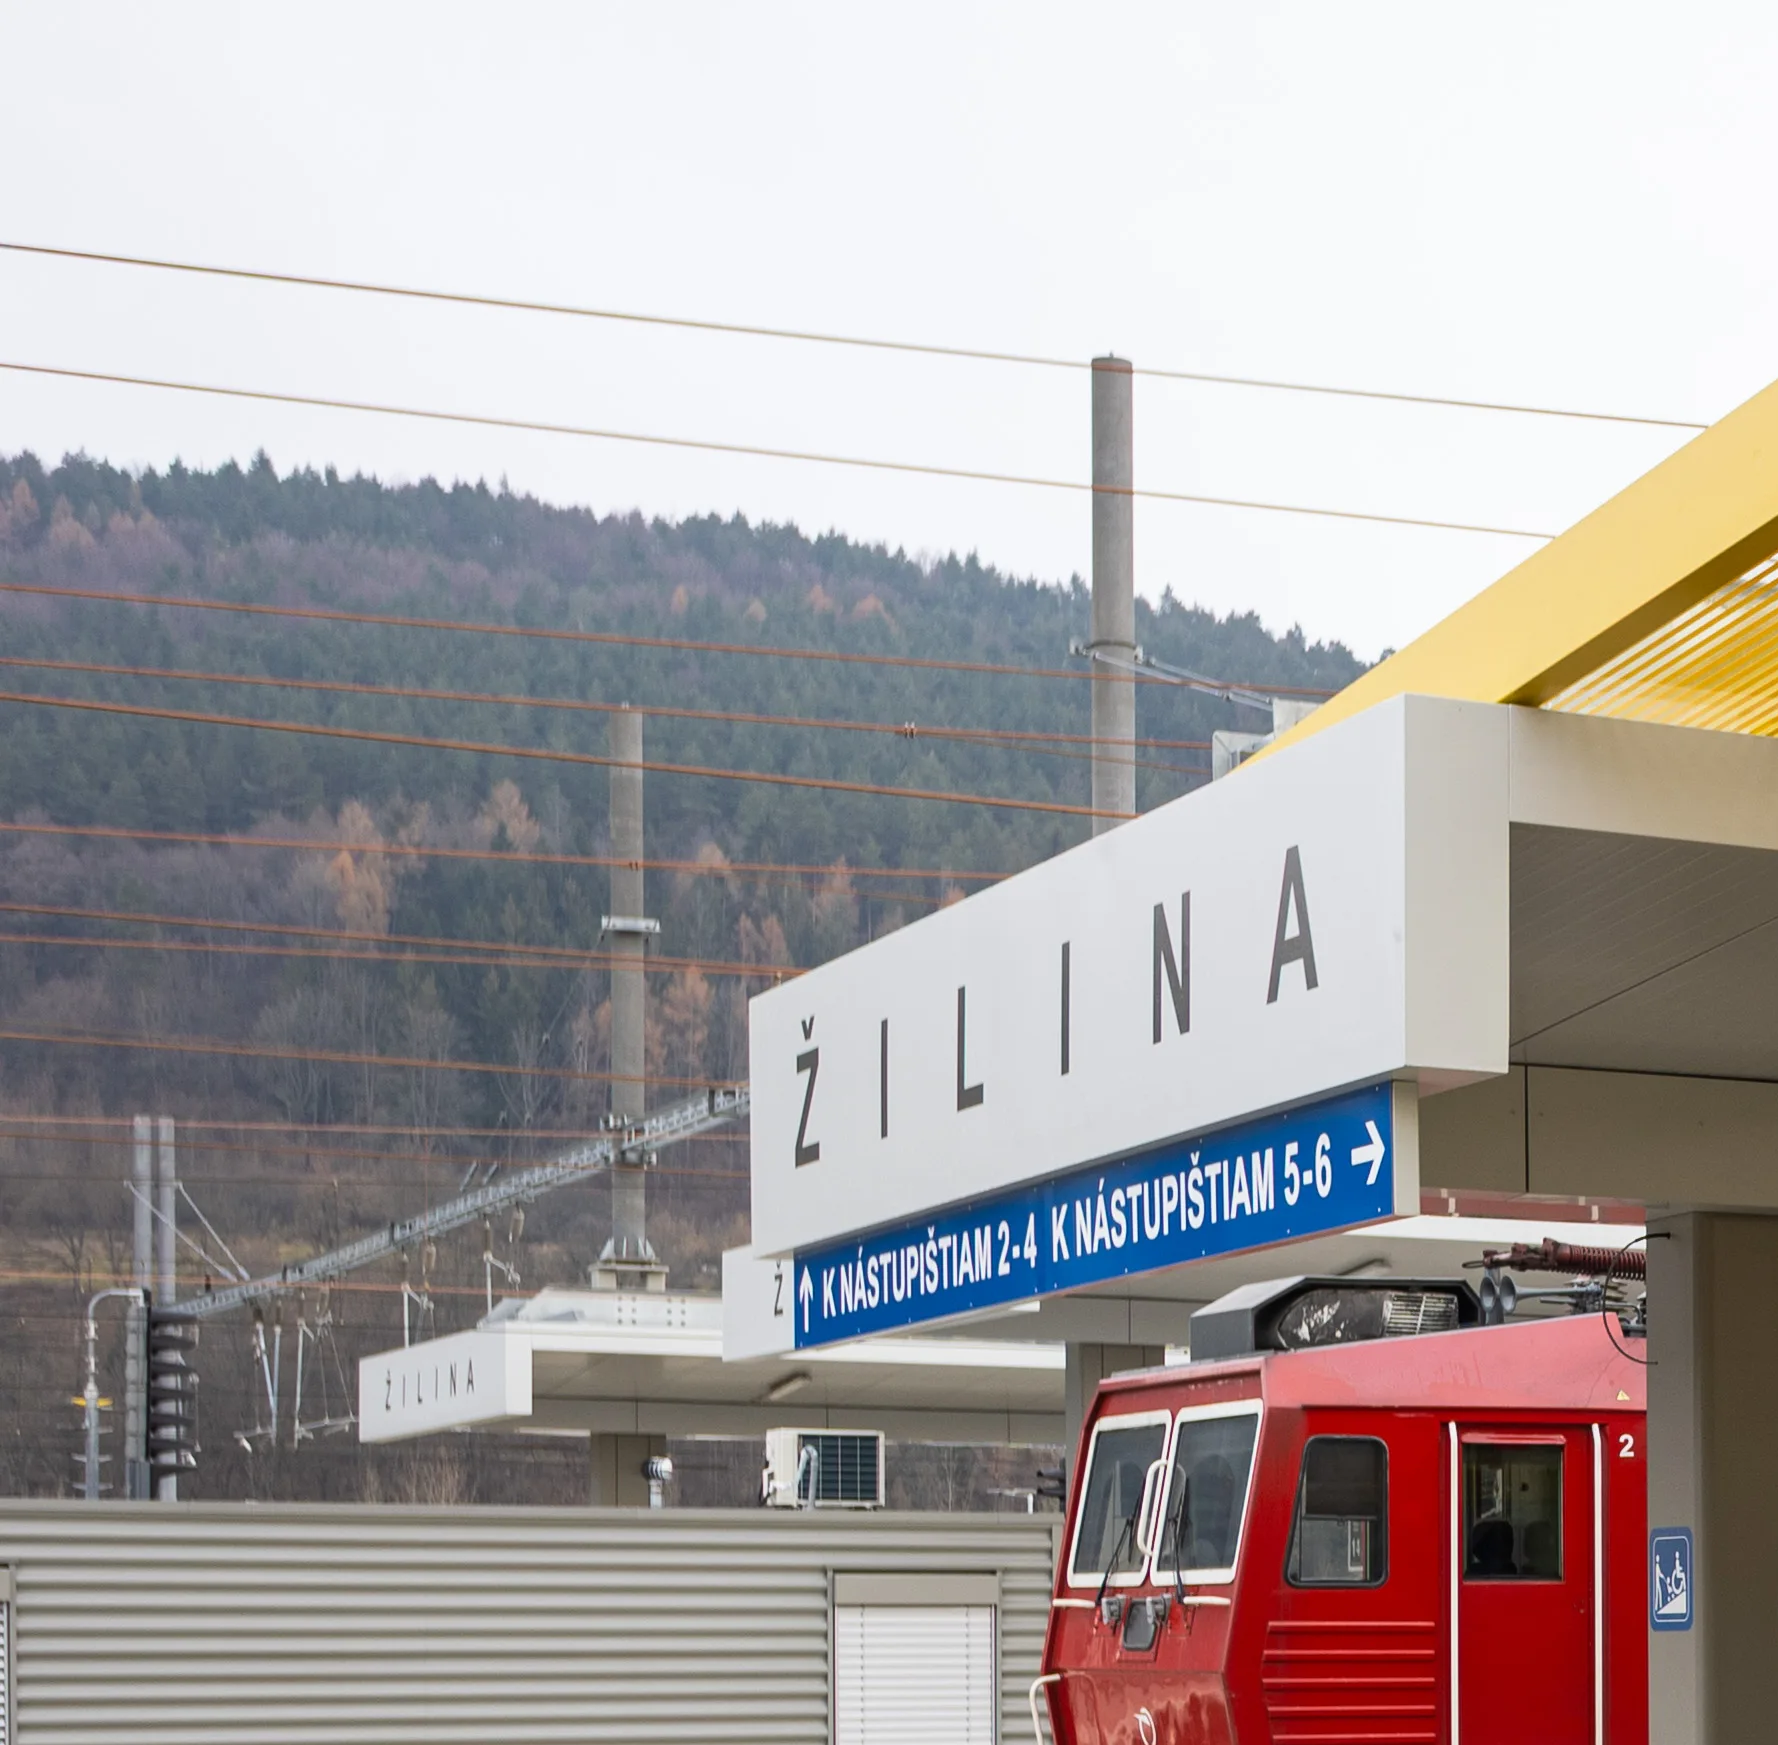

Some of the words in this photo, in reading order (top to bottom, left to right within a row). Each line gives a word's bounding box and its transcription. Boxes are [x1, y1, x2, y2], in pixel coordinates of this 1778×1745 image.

[795, 844, 1319, 1168] ŽILINA
[822, 1267, 837, 1318] K
[839, 1225, 993, 1315] NÁSTUPIŠTIAM
[997, 1213, 1037, 1276] 2-4
[1052, 1203, 1070, 1263] K
[1075, 1152, 1275, 1257] NÁSTUPIŠTIAM
[1284, 1133, 1332, 1206] 5-6
[385, 1357, 475, 1412] ŽILINA
[1618, 1433, 1635, 1458] 2
